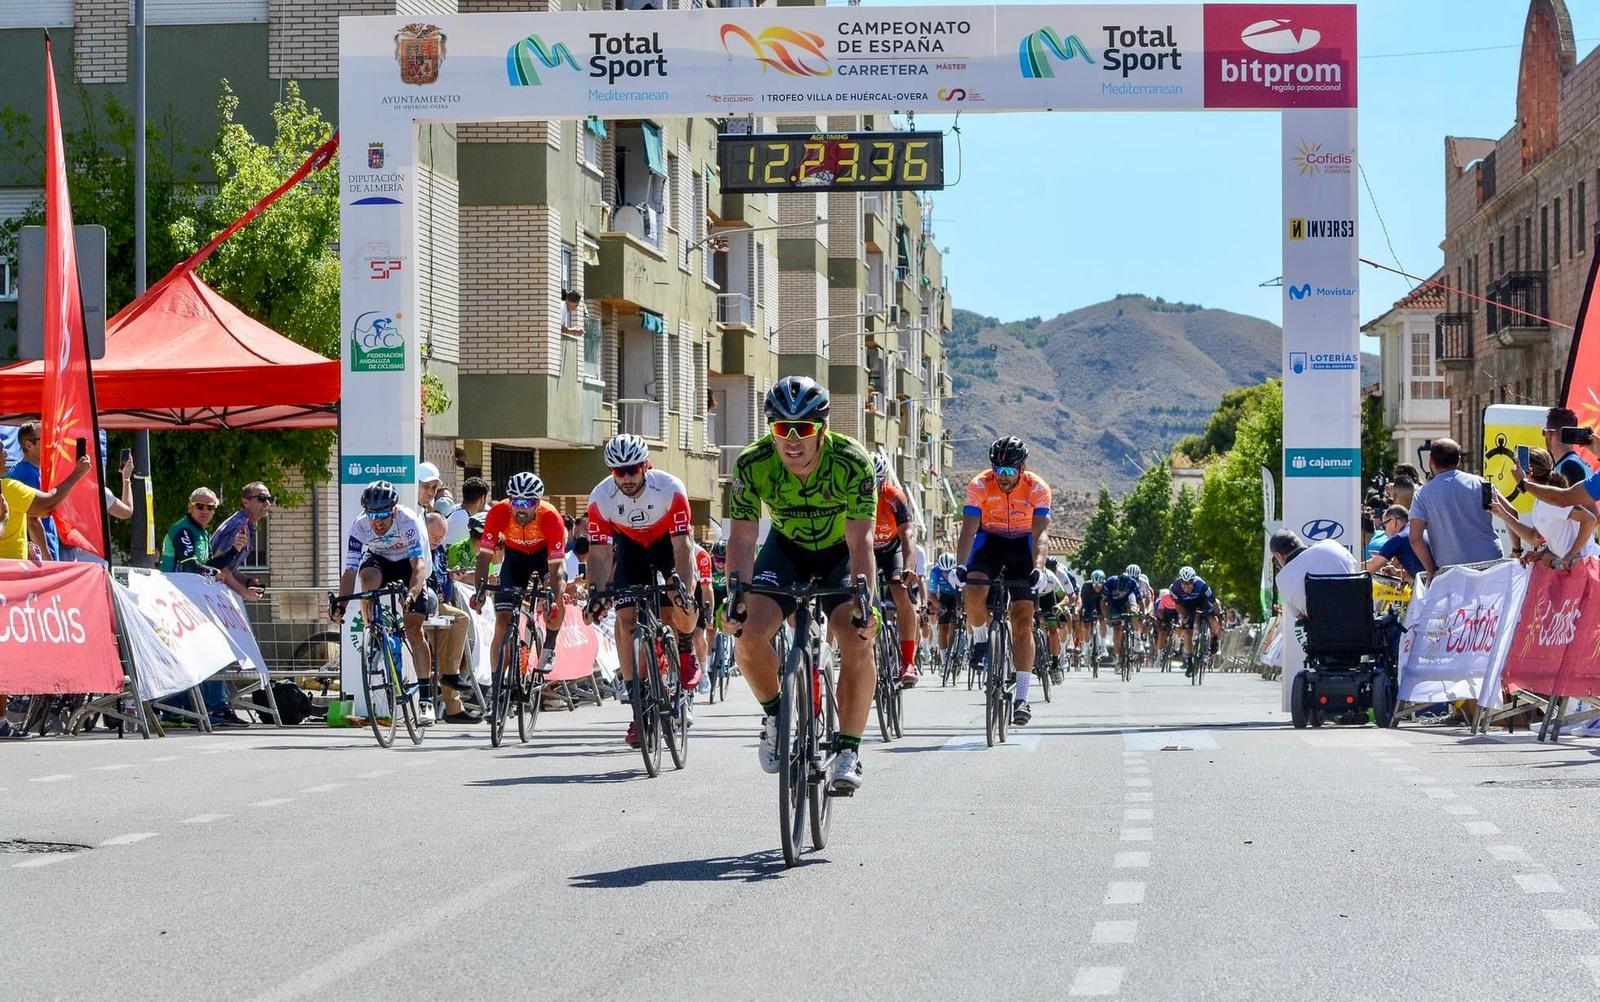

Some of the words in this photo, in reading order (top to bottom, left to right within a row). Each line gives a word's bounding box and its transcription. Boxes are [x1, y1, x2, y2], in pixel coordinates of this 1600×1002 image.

[837, 21, 971, 36] CAMPEONATO
[1102, 25, 1178, 48] Total
[588, 32, 663, 55] Total
[837, 40, 862, 53] DE
[869, 36, 945, 53] ESPAÑA
[589, 54, 668, 85] Sport
[837, 64, 930, 76] CARRETERA
[936, 63, 967, 71] MÁSTER
[1102, 48, 1182, 78] Sport
[1221, 58, 1342, 87] bitprom
[1102, 82, 1183, 96] Mediterranean
[1271, 83, 1296, 93] regalo
[1296, 82, 1342, 93] promocional
[381, 95, 461, 105] AYUNTAMIENTO
[588, 88, 670, 101] Mediterranean
[767, 94, 805, 102] TROFEO
[806, 93, 835, 101] VILLA
[835, 93, 848, 101] DE
[850, 91, 929, 101] HUÉRCAL-OVERA
[748, 142, 929, 184] 12.23.36
[1306, 152, 1353, 164] Cofidis
[348, 172, 405, 183] DIPUTACIÓN
[349, 184, 362, 193] DE
[363, 183, 404, 193] ALMERÍA
[1316, 286, 1356, 296] Movistar
[1310, 352, 1358, 362] LOTERÍAS
[1309, 456, 1353, 469] cajamar
[364, 463, 408, 477] cajamar
